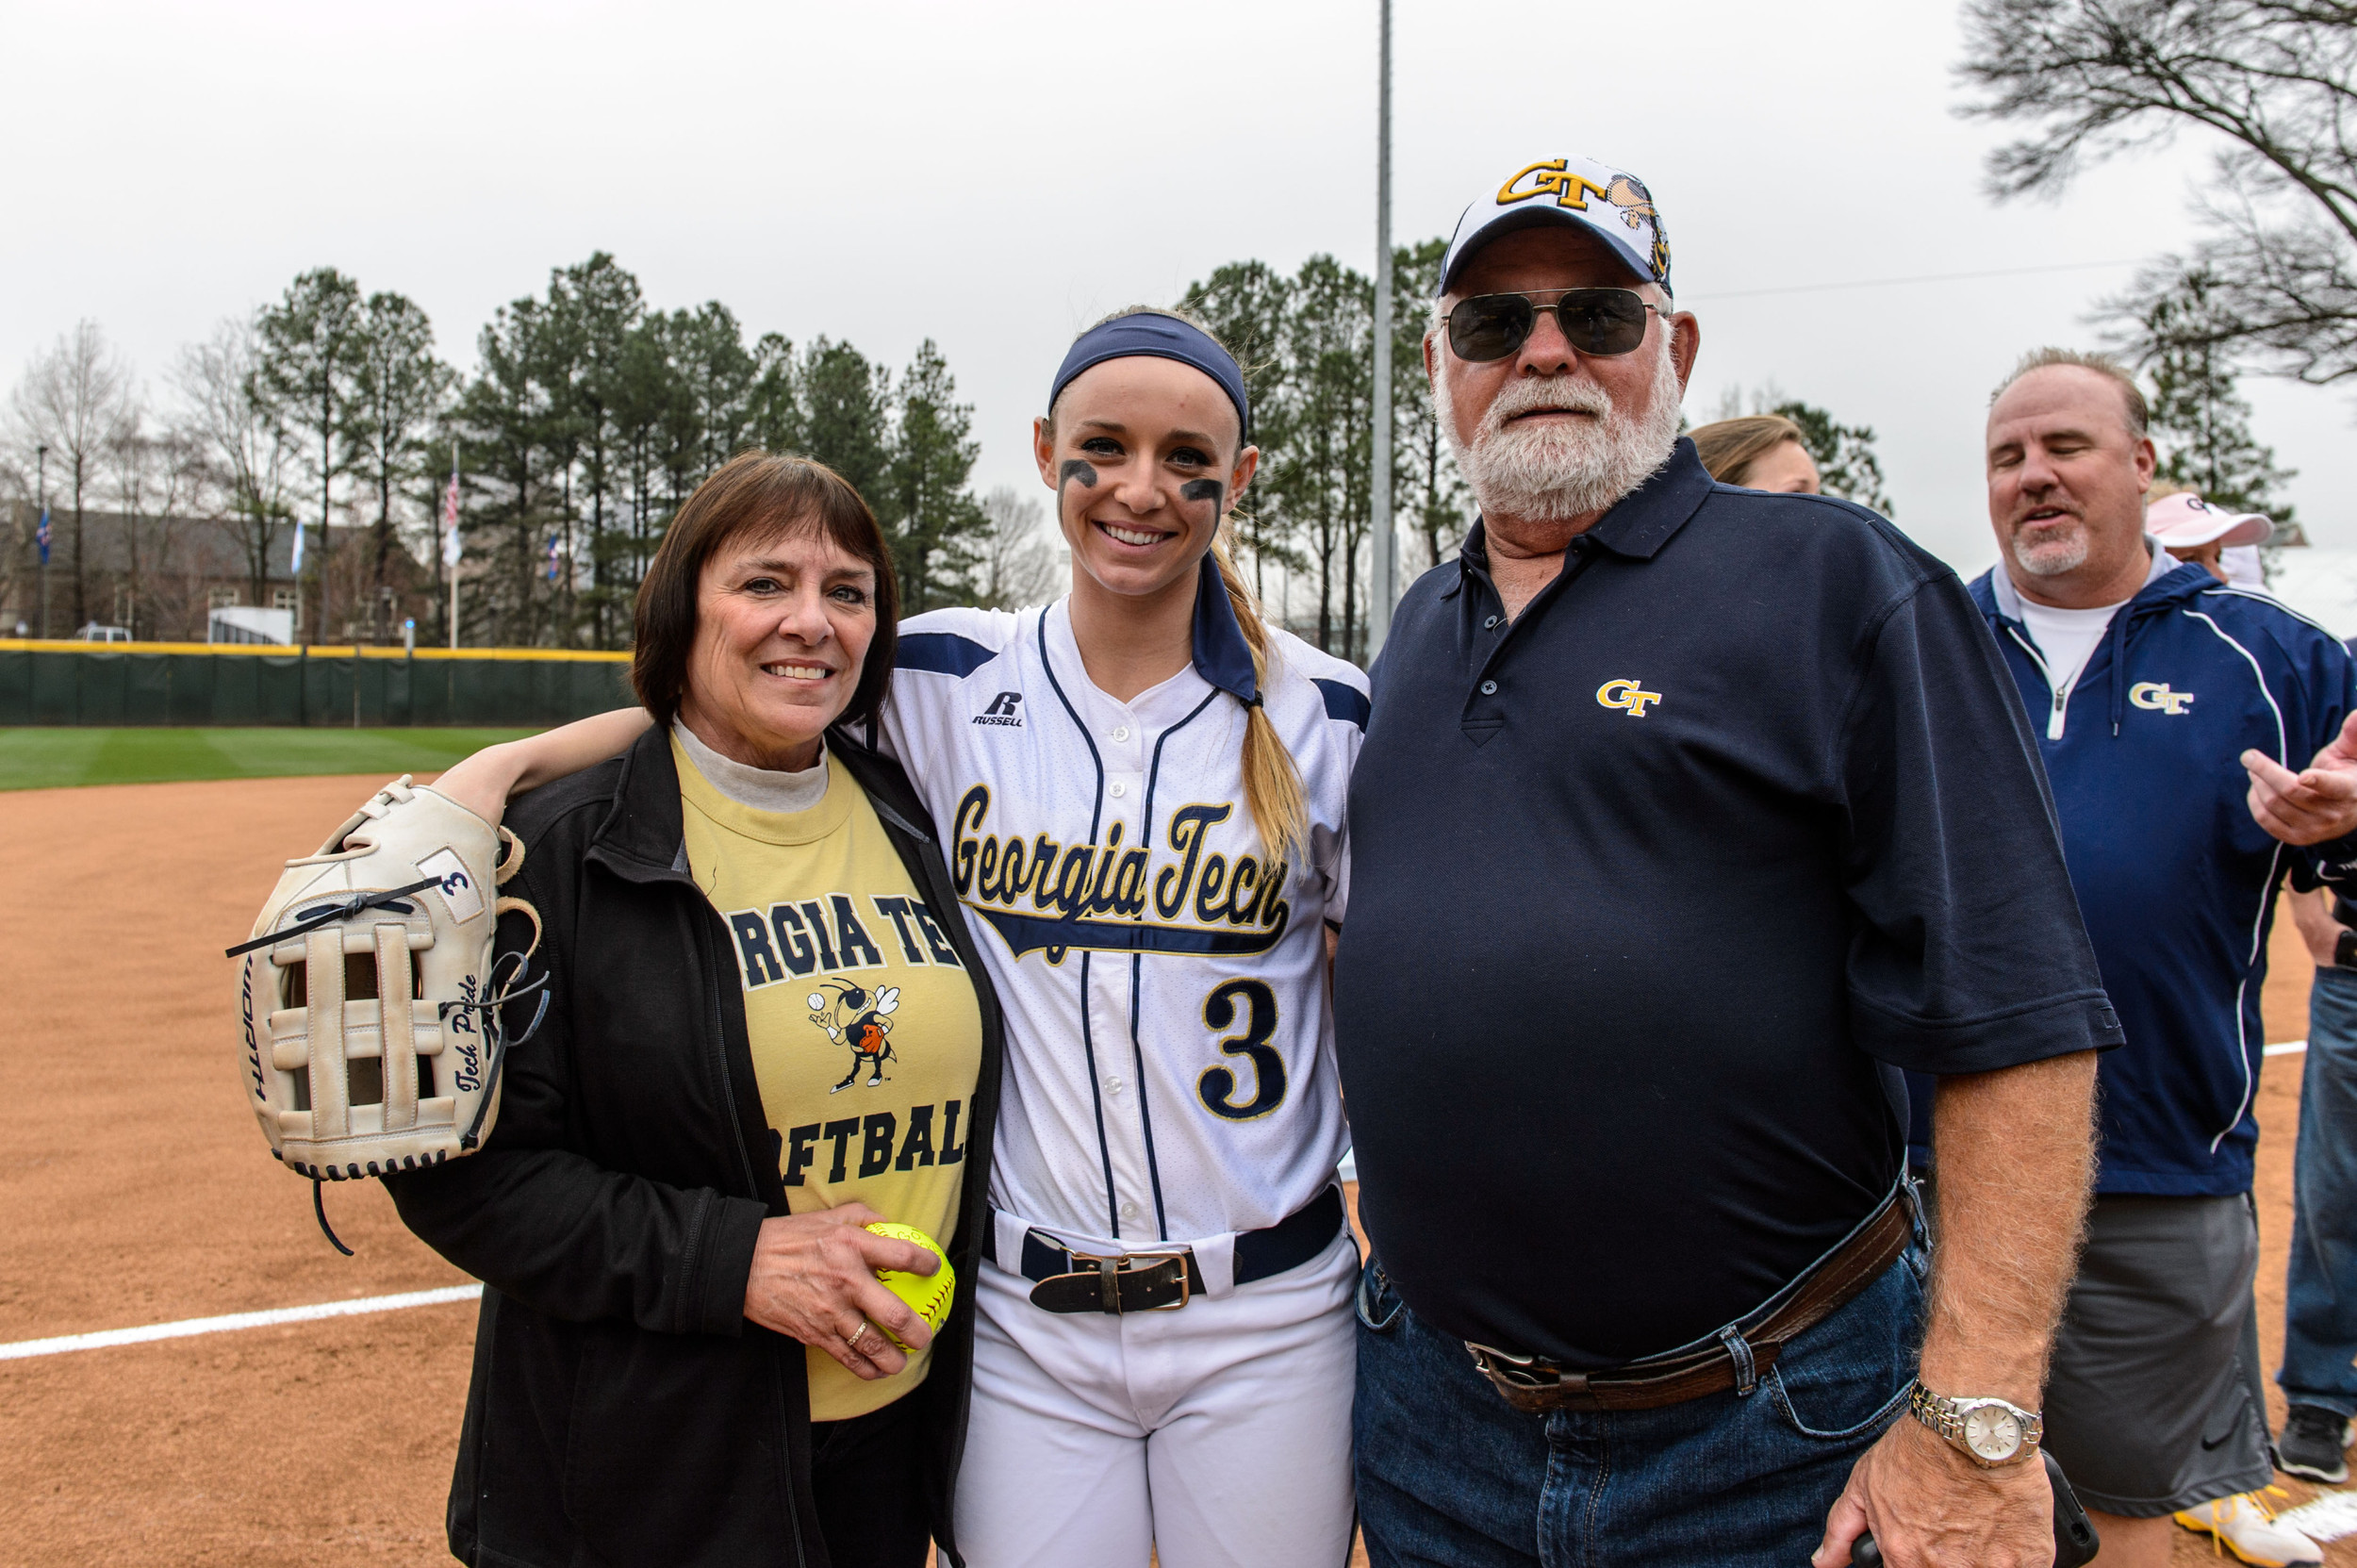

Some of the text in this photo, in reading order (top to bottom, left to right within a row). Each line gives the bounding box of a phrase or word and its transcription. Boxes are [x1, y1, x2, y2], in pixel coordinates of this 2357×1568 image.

[1496, 158, 1607, 212] GT
[972, 716, 1022, 727] RUSSELL
[1596, 679, 1662, 717] GT
[2129, 682, 2194, 715] GT
[442, 871, 469, 896] 3
[952, 784, 1151, 966] Georgia
[719, 892, 966, 992] RGIA TE
[241, 952, 267, 1102] WORTH
[452, 974, 479, 1093] Tech Pride
[1195, 977, 1288, 1123] 3
[769, 1095, 977, 1187] FTBAL
